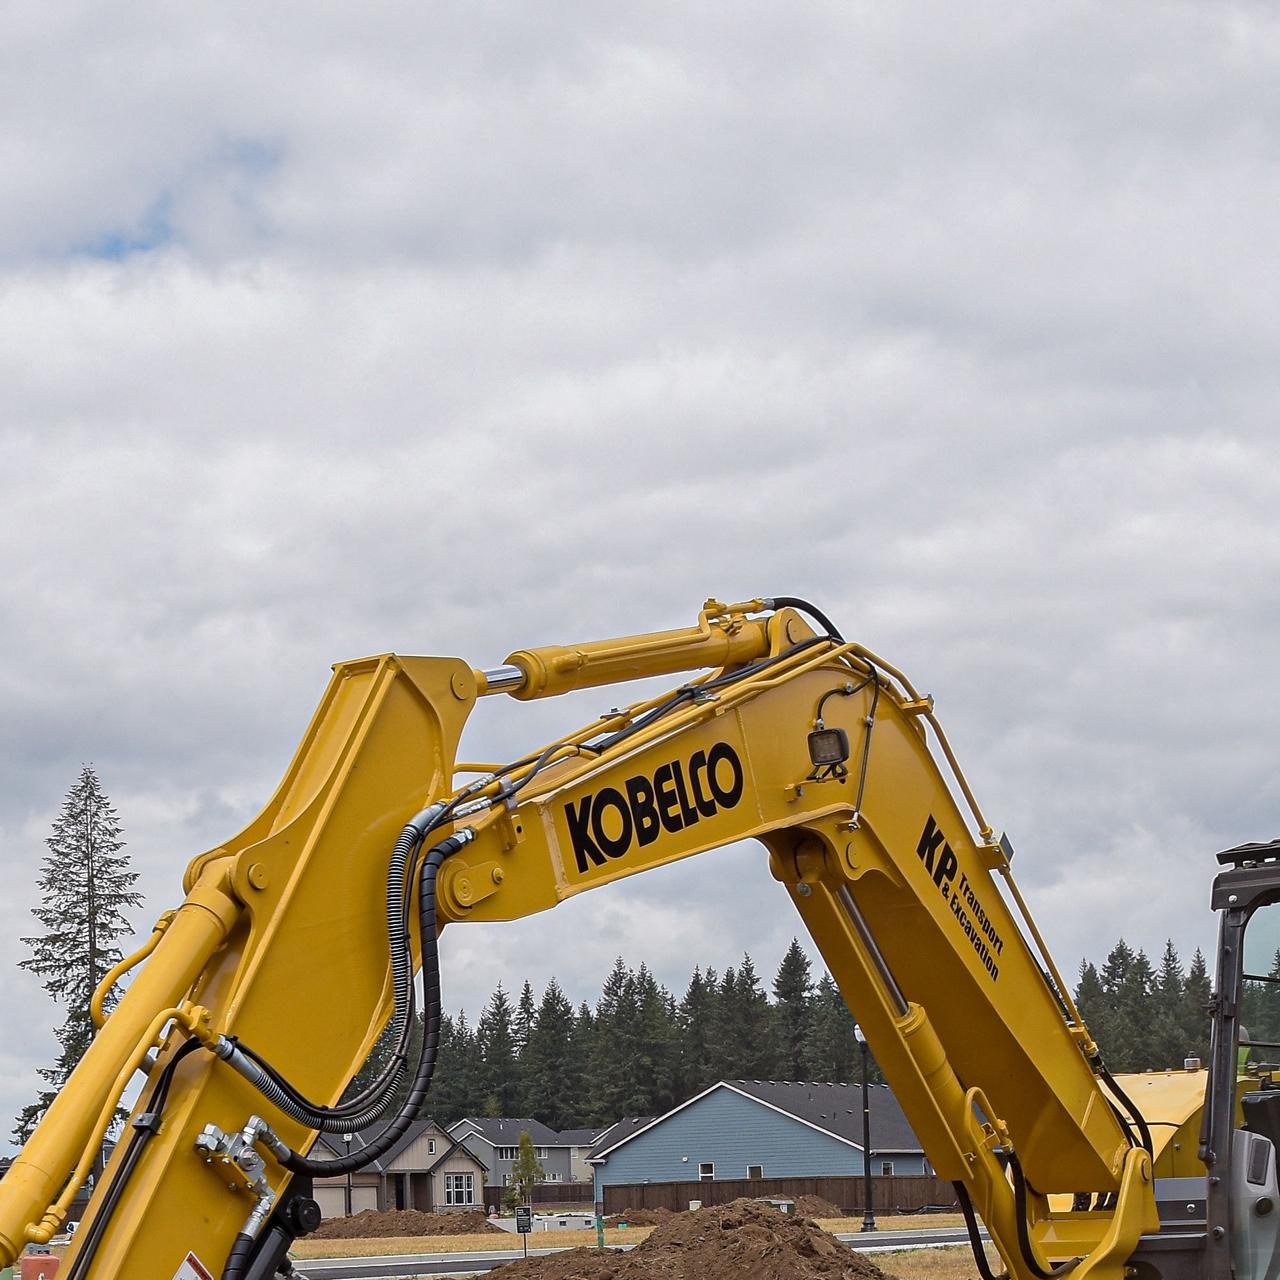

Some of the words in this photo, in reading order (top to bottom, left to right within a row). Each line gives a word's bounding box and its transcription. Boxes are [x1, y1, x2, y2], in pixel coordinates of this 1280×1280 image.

[564, 742, 744, 874] KOBELCO
[916, 813, 959, 889] KP
[941, 882, 950, 900] &
[949, 892, 1000, 982] Excavation
[958, 872, 1004, 957] Transport
